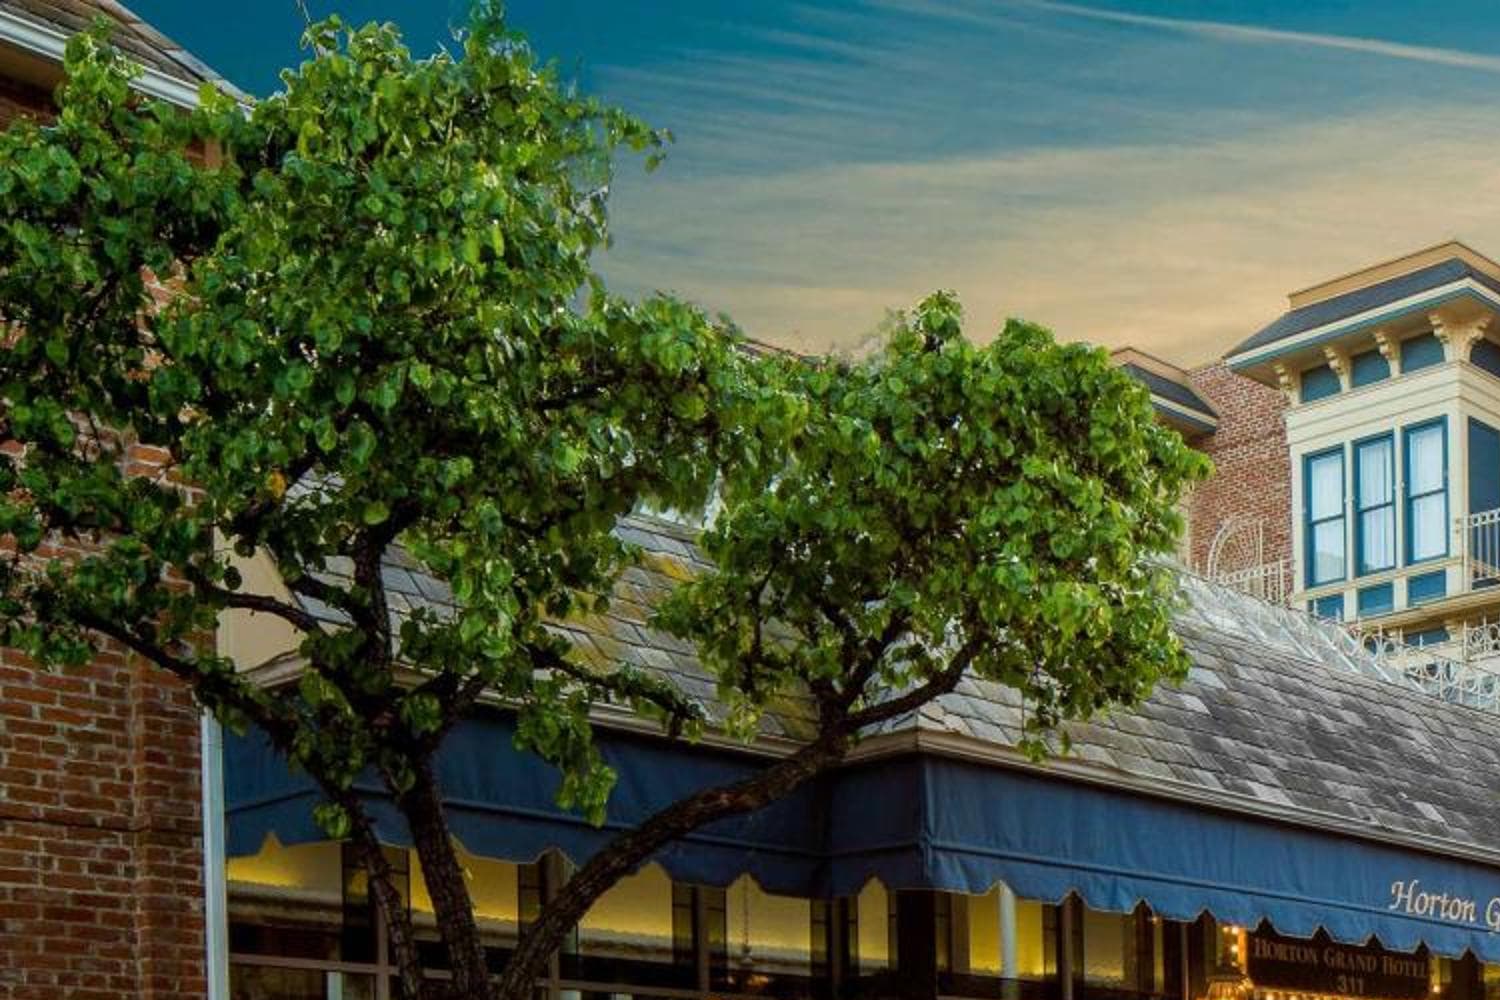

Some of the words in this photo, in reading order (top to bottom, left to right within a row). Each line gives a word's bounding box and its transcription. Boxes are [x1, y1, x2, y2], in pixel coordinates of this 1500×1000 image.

[1389, 879, 1476, 923] Horton
[1323, 947, 1377, 973] GRAND
[1336, 974, 1365, 994] 311
